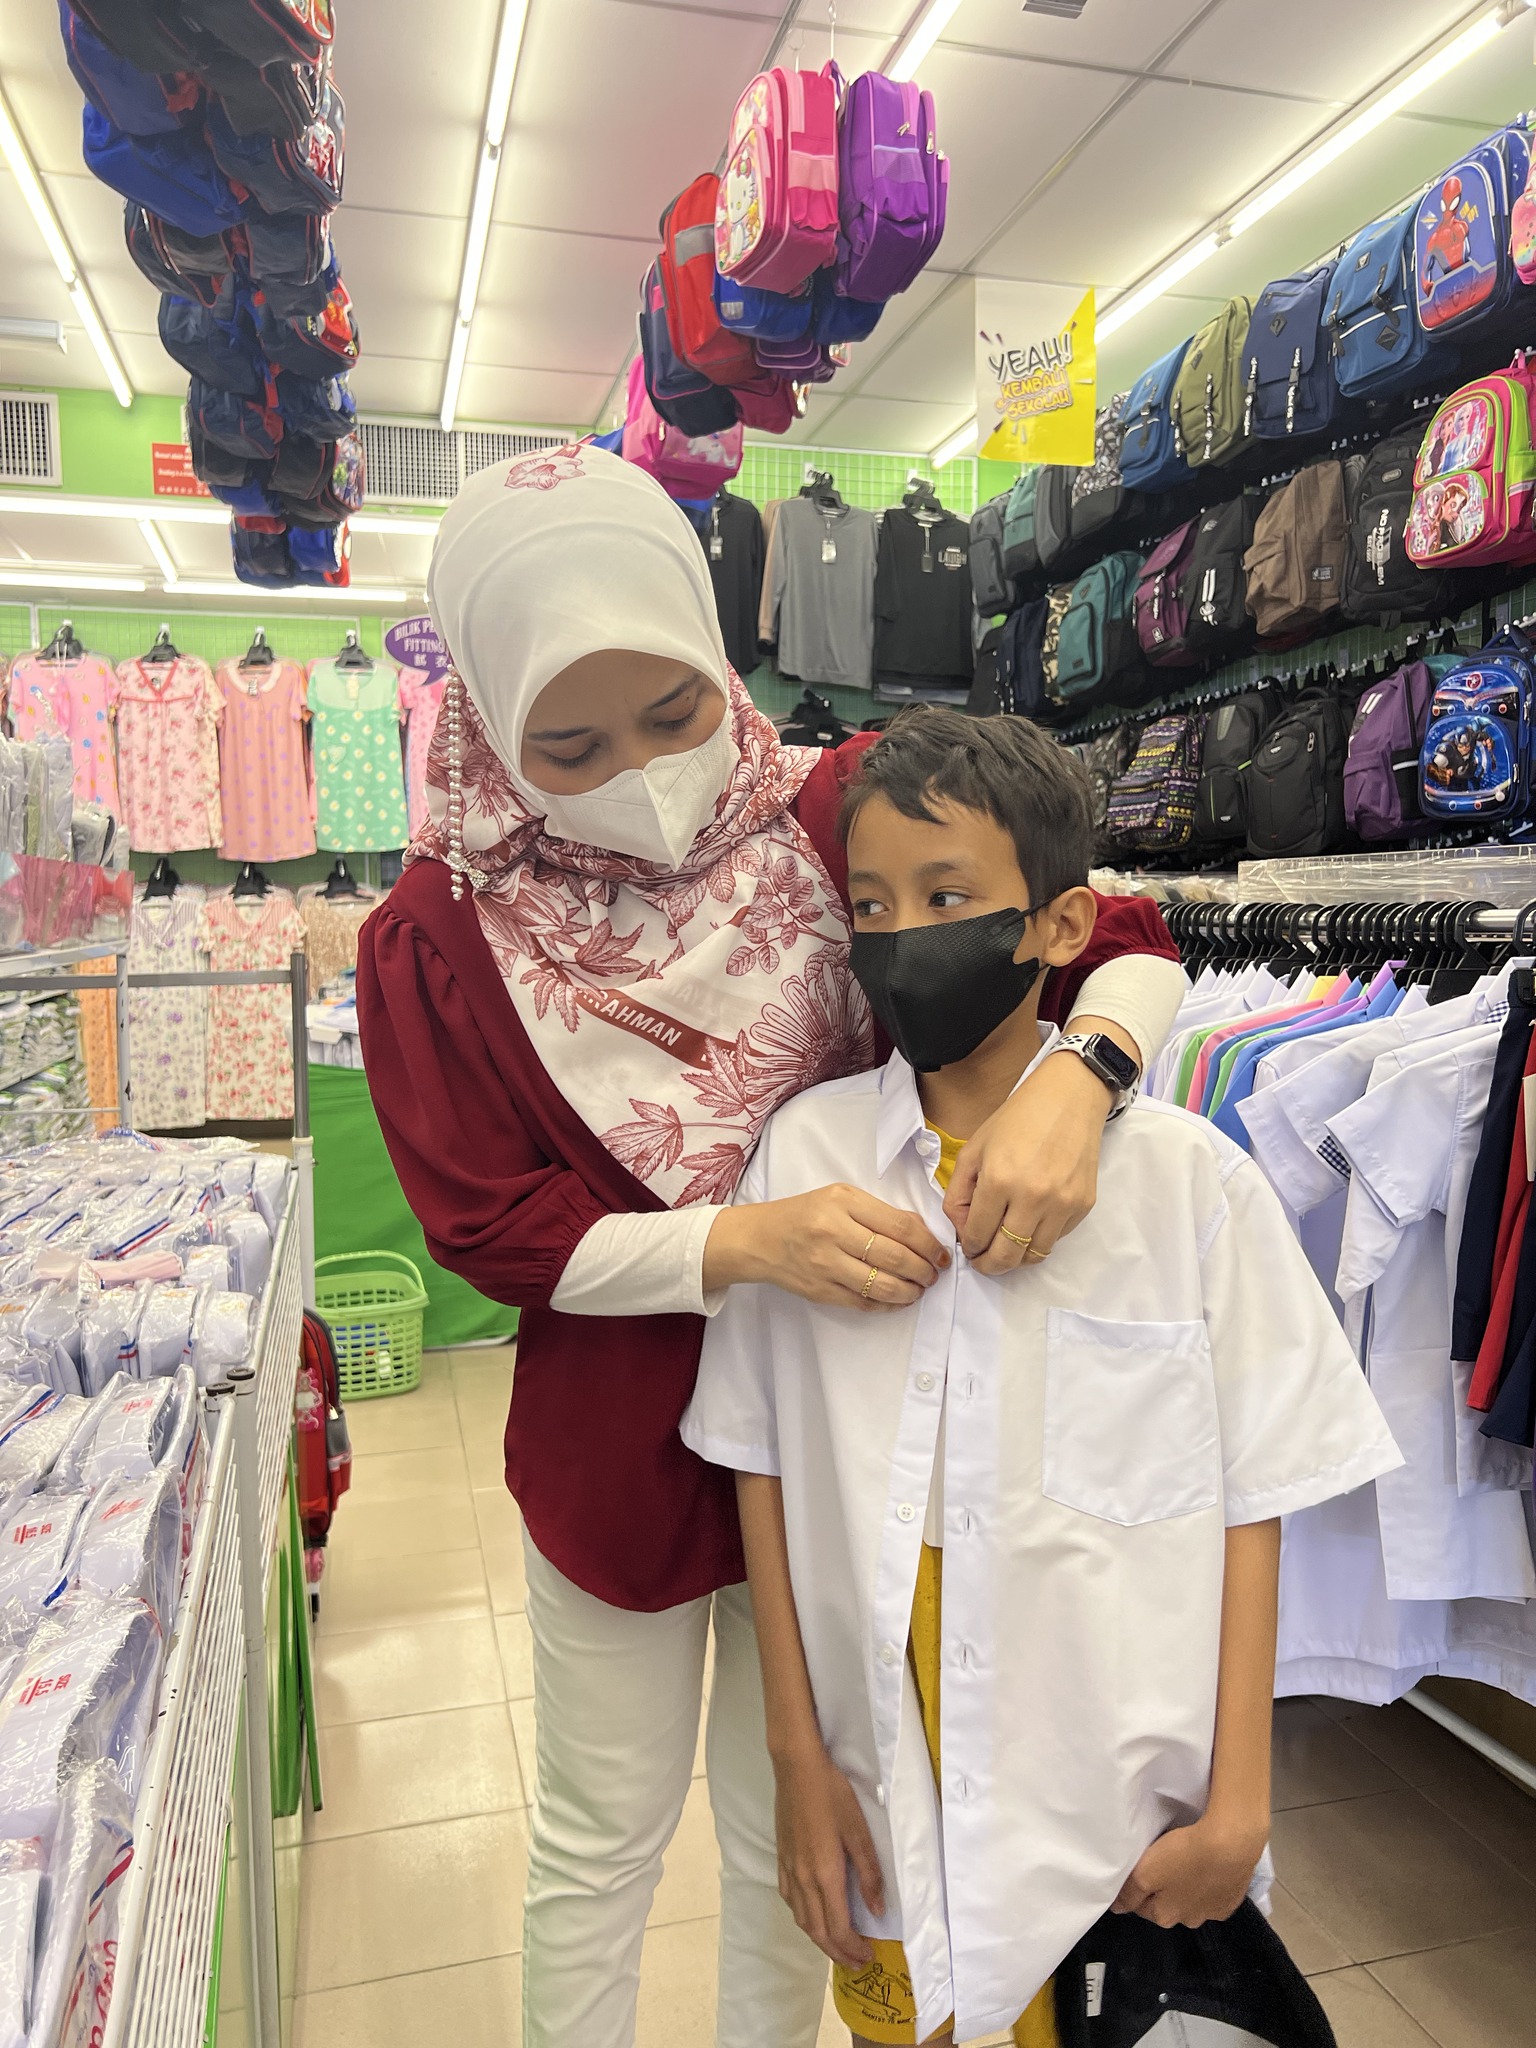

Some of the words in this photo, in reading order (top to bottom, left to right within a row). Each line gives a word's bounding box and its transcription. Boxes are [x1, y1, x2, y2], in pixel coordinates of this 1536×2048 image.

[988, 333, 1071, 381] YEAH!
[1001, 368, 1066, 399] KEMBALI
[1007, 388, 1070, 418] SEKOLAH
[1379, 508, 1390, 527] NO
[1375, 526, 1386, 586] PROBLEM
[34, 1679, 54, 1696] 15.5
[53, 1673, 72, 1691] SIZE
